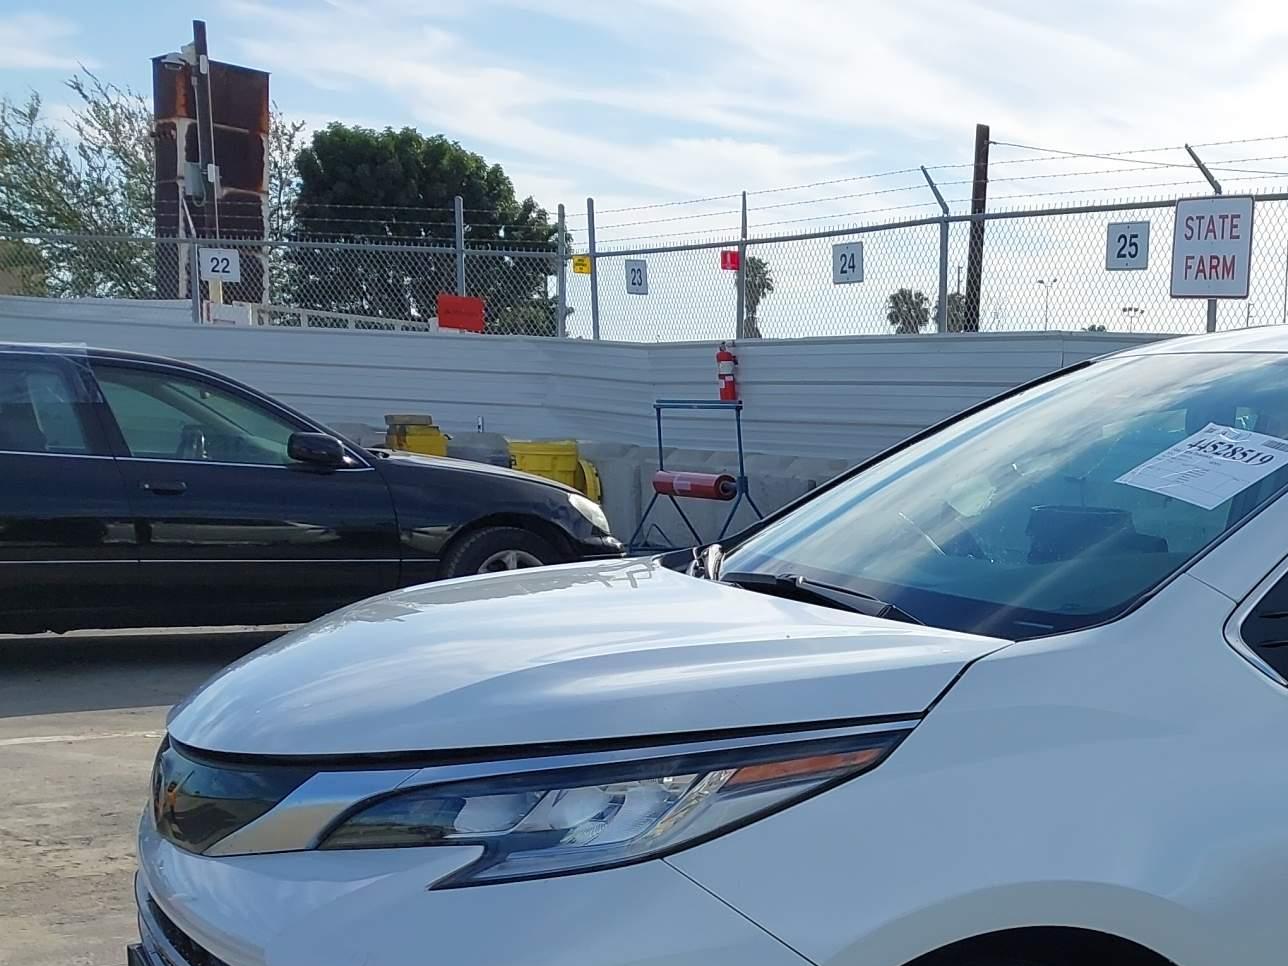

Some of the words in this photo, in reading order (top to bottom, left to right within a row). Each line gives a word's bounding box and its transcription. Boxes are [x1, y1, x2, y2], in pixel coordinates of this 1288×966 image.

[1184, 214, 1241, 240] STATE
[1116, 233, 1139, 259] 25
[210, 257, 231, 274] 22
[840, 252, 856, 274] 24
[1184, 255, 1236, 280] FARM
[630, 268, 643, 287] 23
[1187, 438, 1275, 466] 44528519
